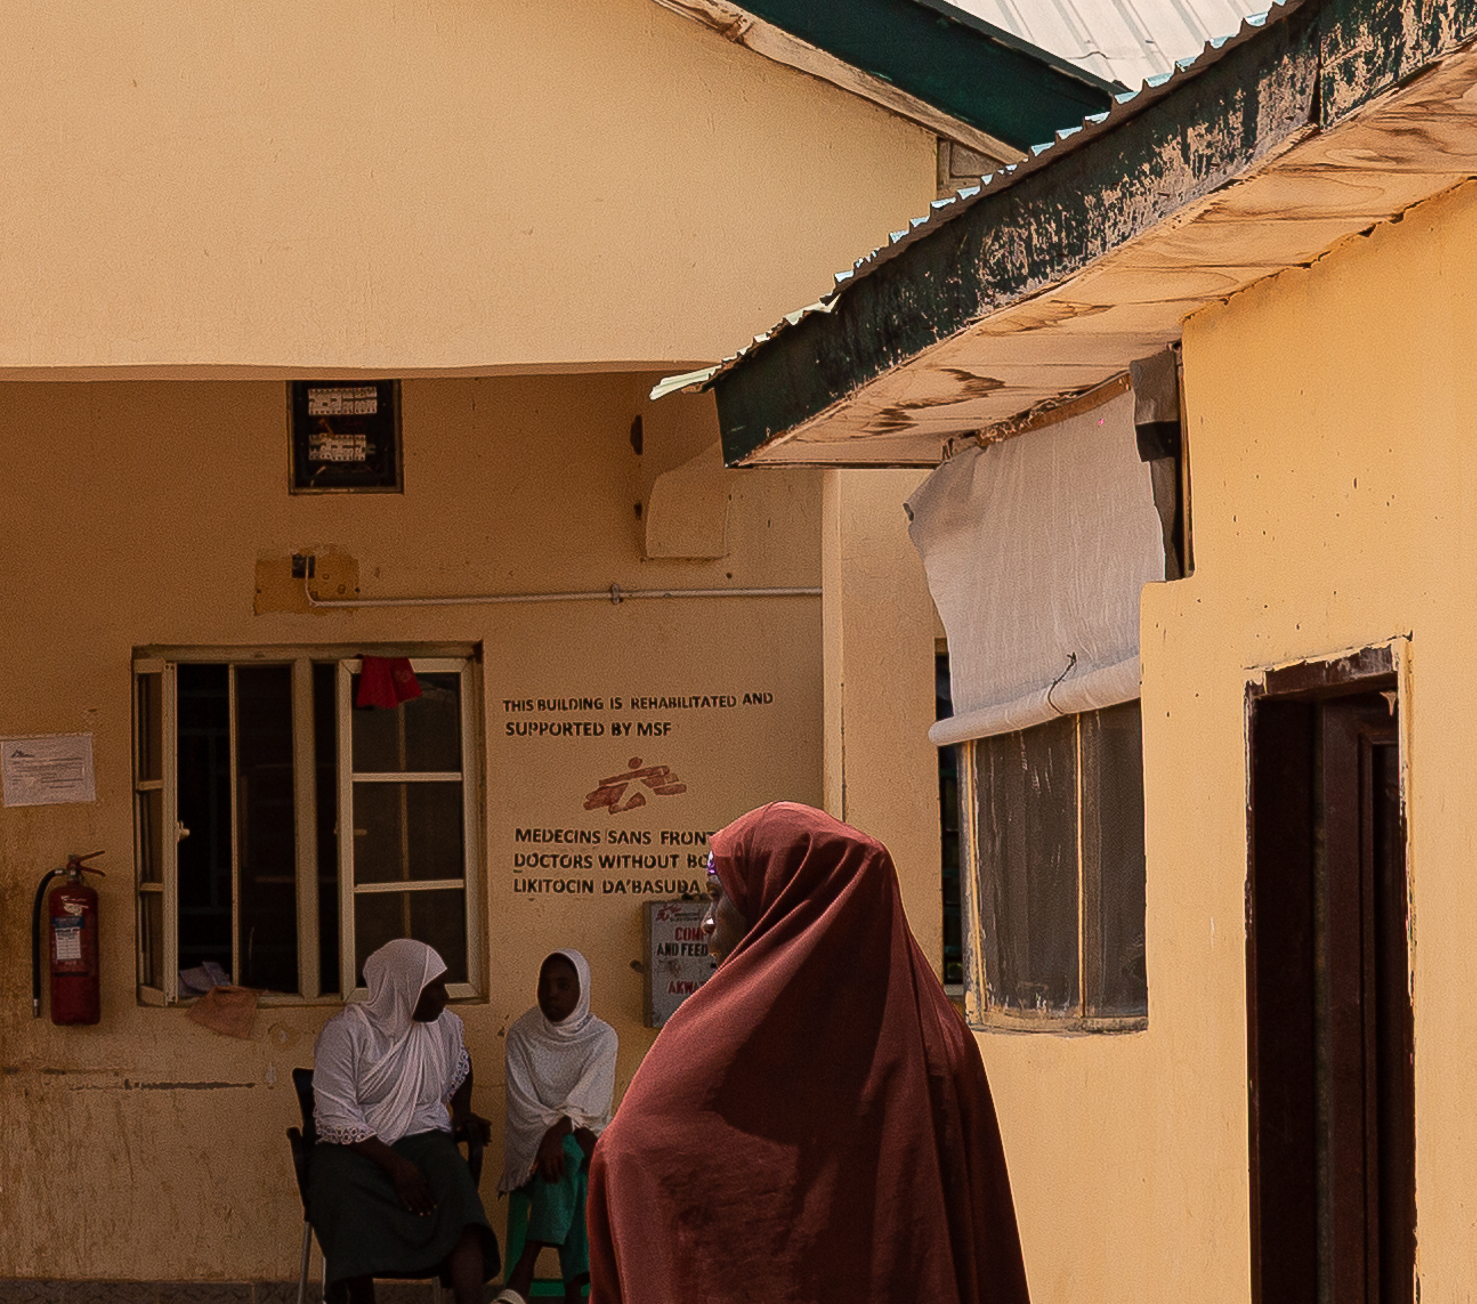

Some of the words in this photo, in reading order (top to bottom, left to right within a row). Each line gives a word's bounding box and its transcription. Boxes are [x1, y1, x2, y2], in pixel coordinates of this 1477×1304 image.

[502, 699, 535, 712] THIS
[537, 697, 604, 711] BUILDING
[610, 696, 623, 710] IS
[630, 695, 737, 709] REHABILITATED
[742, 692, 774, 705] AND
[505, 721, 605, 737] SUPPORTED
[611, 721, 632, 737] BY
[637, 721, 672, 737] MSF
[515, 827, 601, 845] MEDECINS
[607, 830, 652, 845] SANS
[514, 852, 593, 869] DOCTORS
[598, 853, 680, 869] WITHOUT
[514, 878, 594, 894] LIKITOCIN
[657, 942, 679, 956] AND
